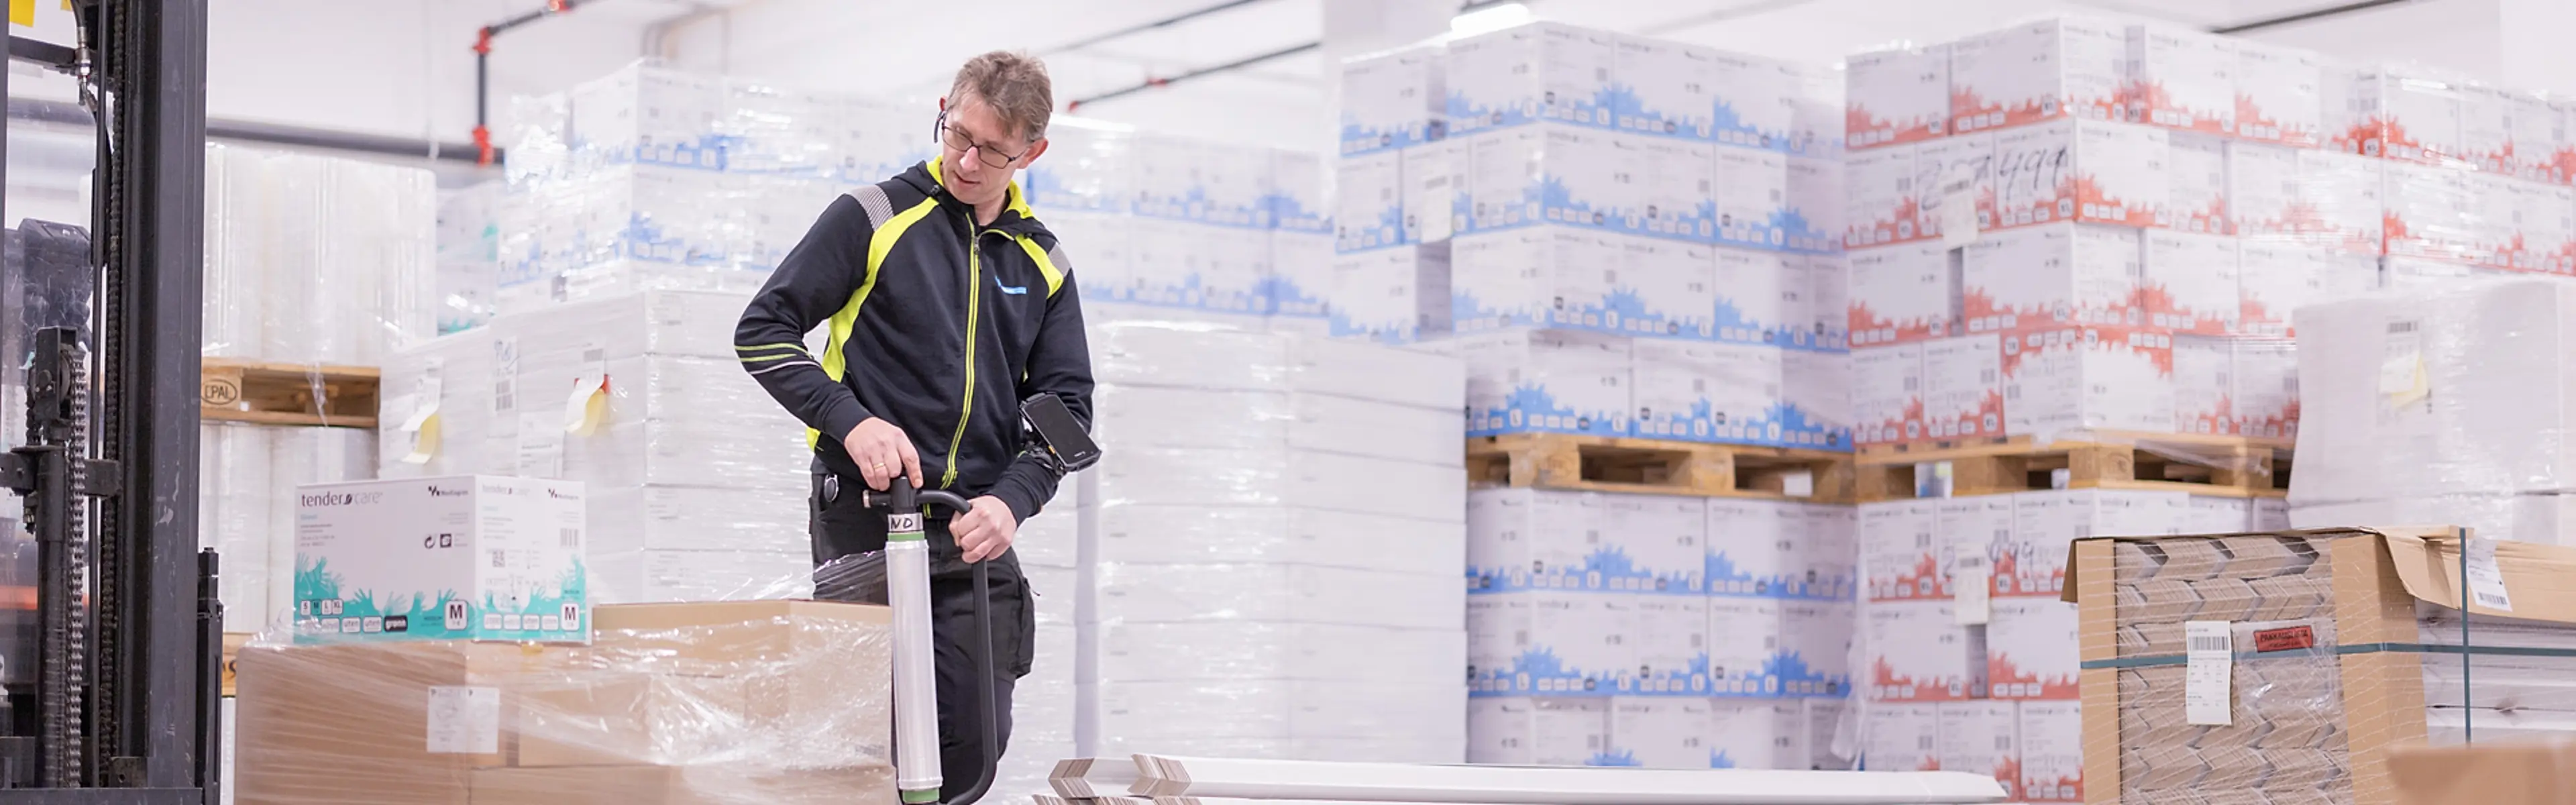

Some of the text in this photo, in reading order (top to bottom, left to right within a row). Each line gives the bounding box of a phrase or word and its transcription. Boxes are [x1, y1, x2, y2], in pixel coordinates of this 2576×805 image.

[301, 491, 380, 507] tender care
[449, 604, 463, 619] M
[565, 606, 576, 621] M
